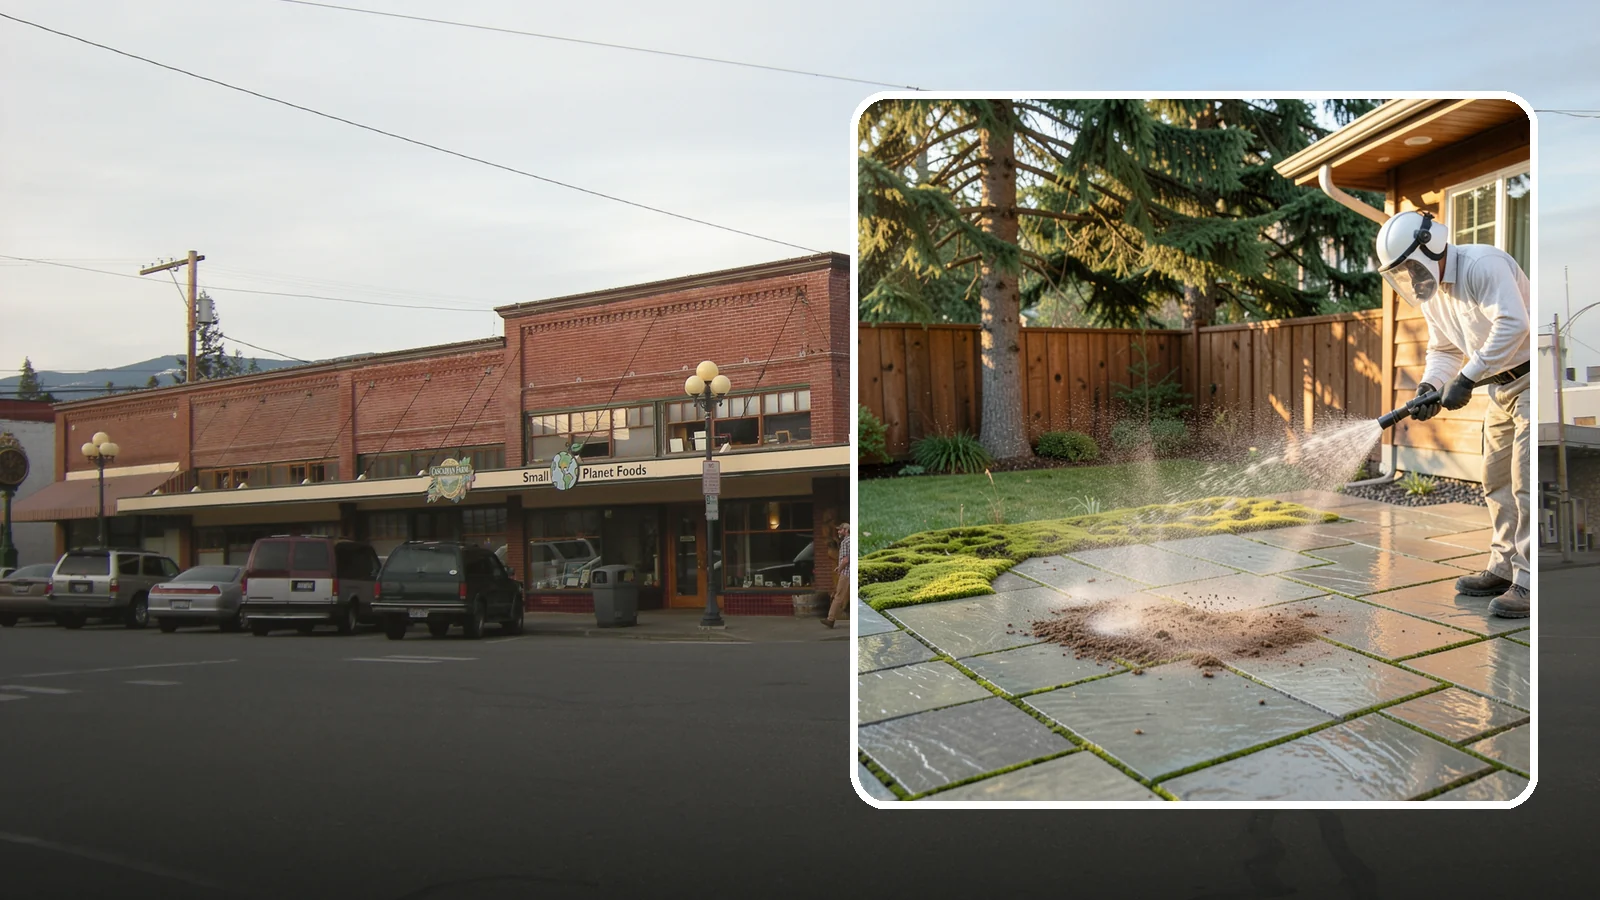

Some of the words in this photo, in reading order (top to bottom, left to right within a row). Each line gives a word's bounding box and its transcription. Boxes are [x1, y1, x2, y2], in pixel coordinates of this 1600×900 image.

[523, 470, 549, 483] Small
[583, 467, 614, 479] Planet
[617, 464, 647, 477] Foods
